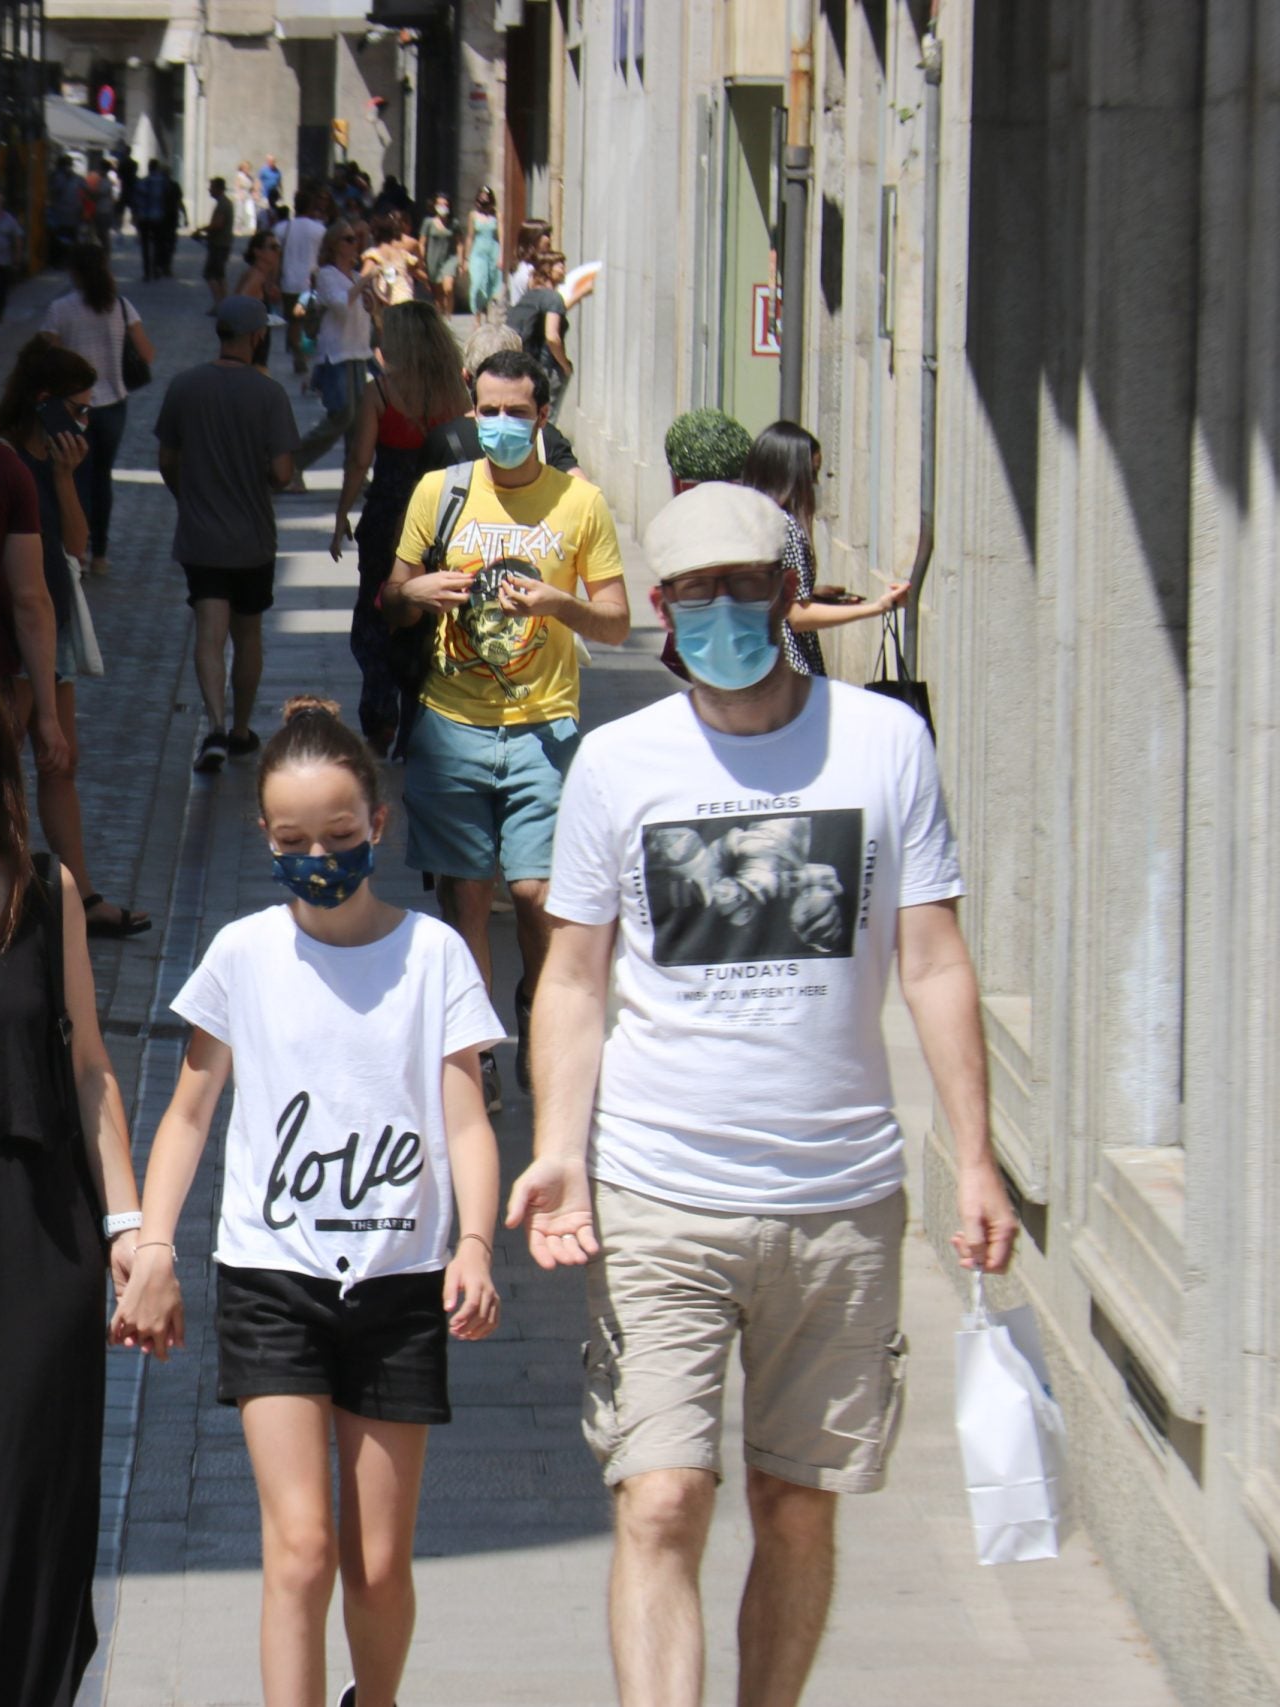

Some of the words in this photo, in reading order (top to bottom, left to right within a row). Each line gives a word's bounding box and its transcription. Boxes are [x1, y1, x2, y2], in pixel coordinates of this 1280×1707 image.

[447, 519, 564, 568] ANTHRAX
[696, 796, 800, 815] FEELINGS
[860, 840, 877, 930] CREATE
[705, 963, 800, 981] FUNDAYS
[712, 990, 736, 1000] YOU
[740, 987, 794, 999] WEREN'T
[800, 985, 828, 997] HERE
[263, 1091, 424, 1231] love
[351, 1221, 373, 1230] THE
[376, 1219, 412, 1230] EARH
